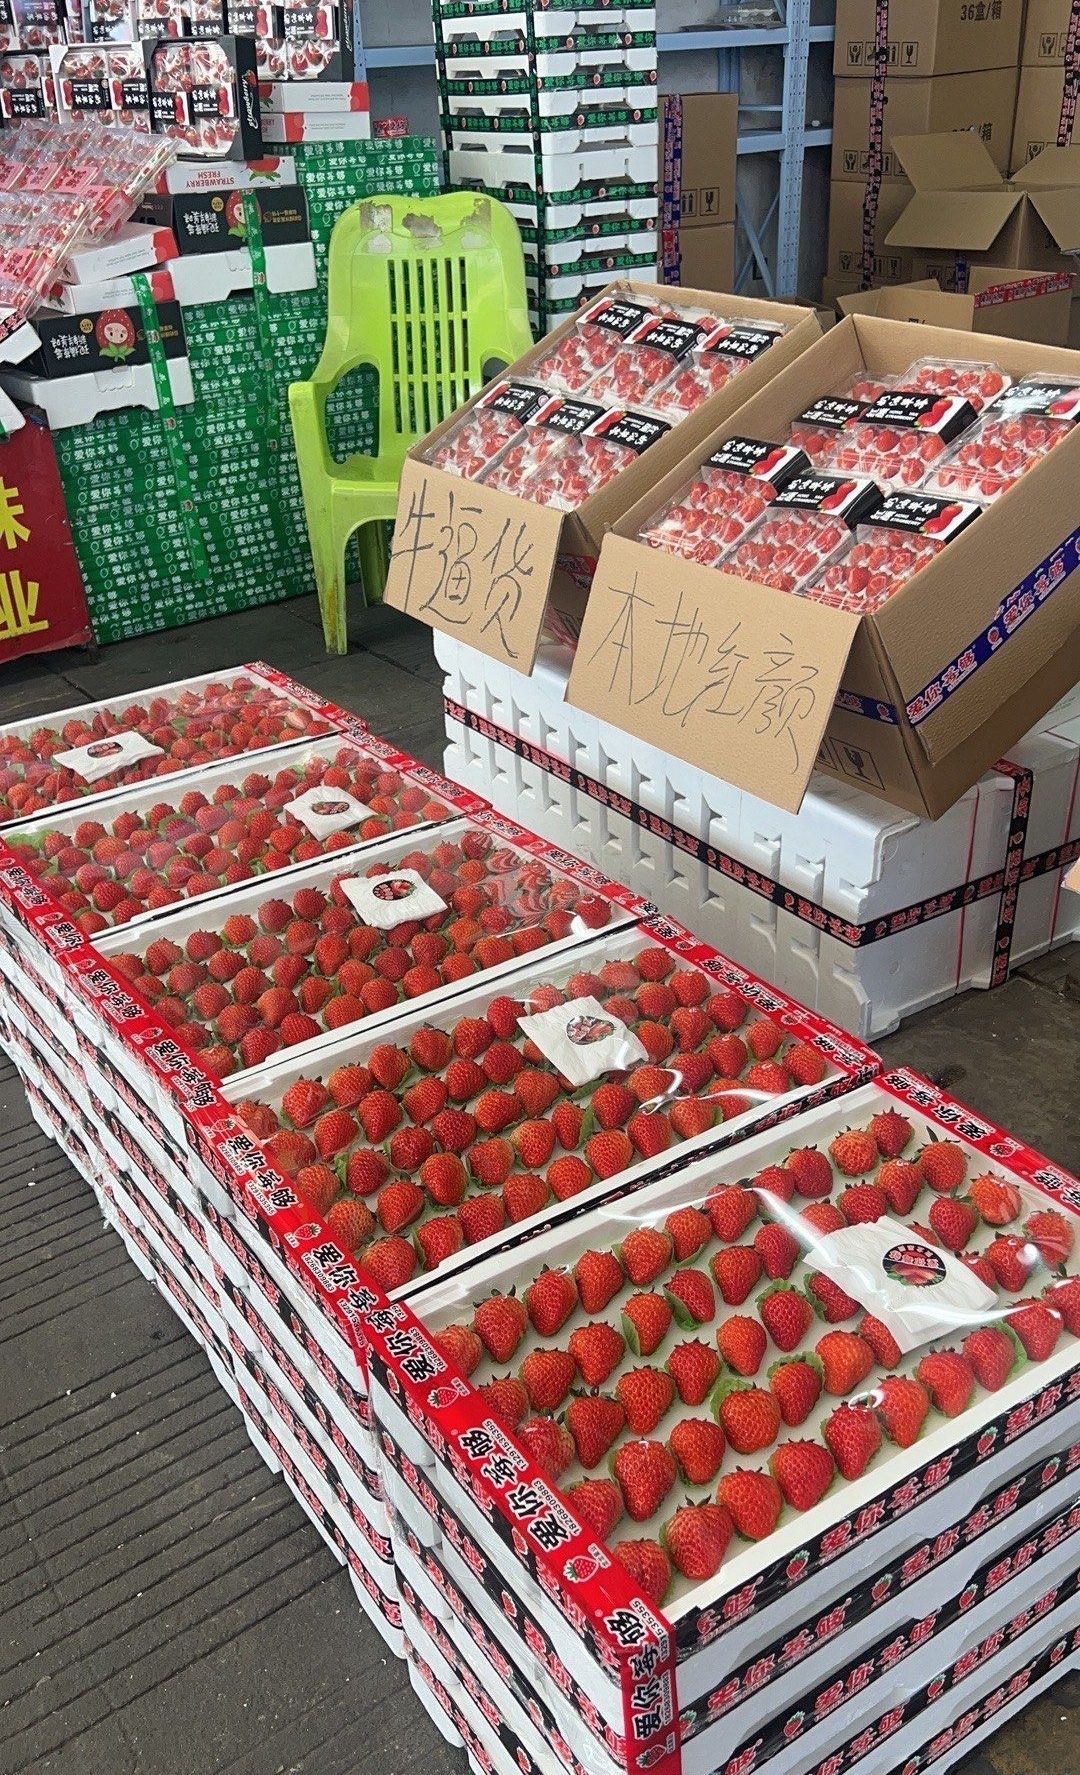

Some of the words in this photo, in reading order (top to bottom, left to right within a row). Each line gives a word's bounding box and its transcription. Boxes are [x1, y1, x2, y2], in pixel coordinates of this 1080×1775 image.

[186, 177, 235, 188] STRAWBERRY
[198, 171, 221, 179] FRESH
[587, 571, 819, 775] 本地红颜
[227, 1133, 298, 1208] 爱你莓够
[485, 1420, 527, 1470] 13291535355
[461, 1429, 569, 1550] 爱你莓够
[533, 1480, 580, 1535] 18268309883
[607, 1611, 663, 1739] 爱你莓够
